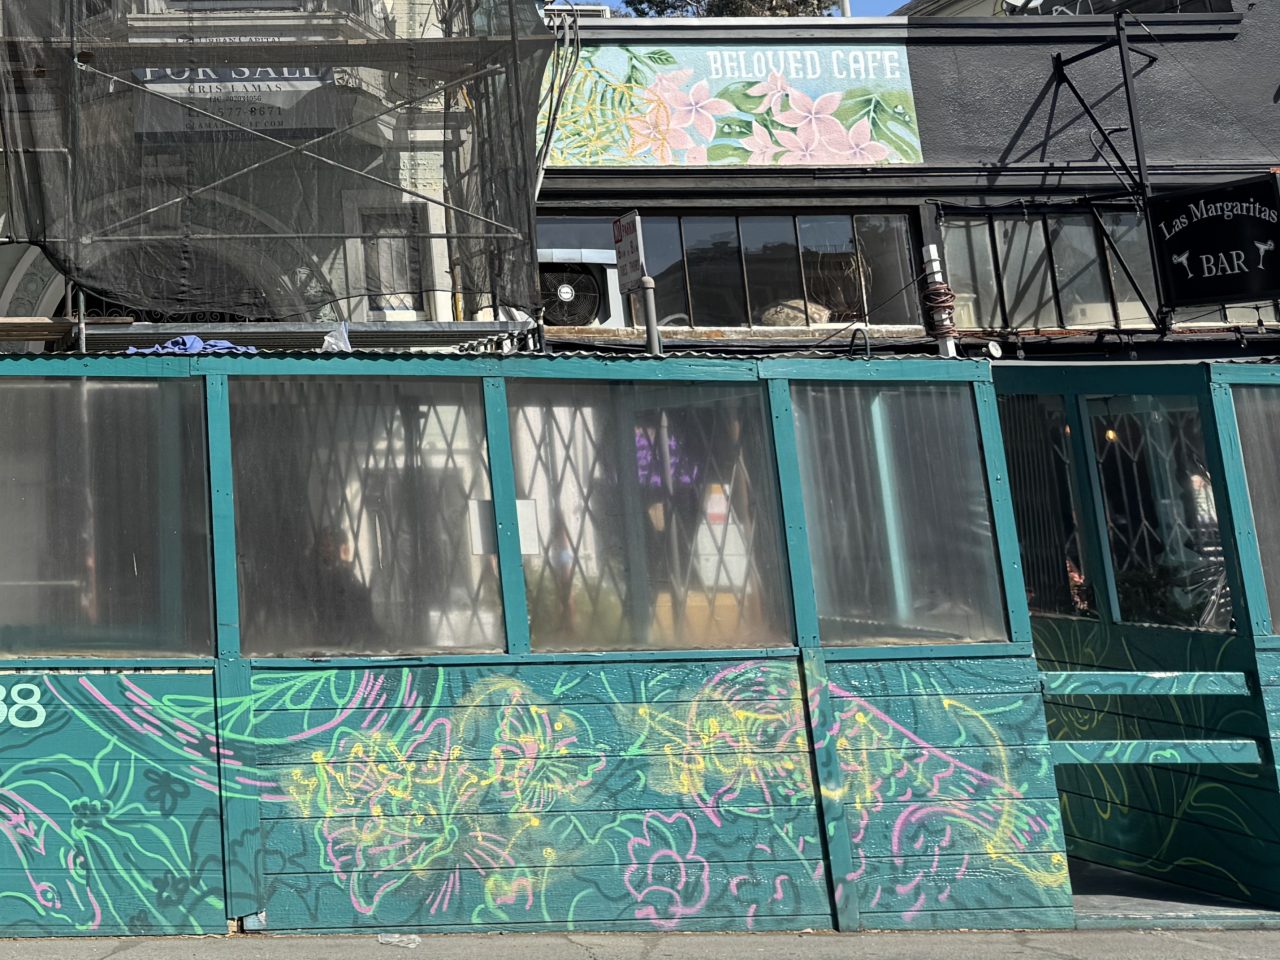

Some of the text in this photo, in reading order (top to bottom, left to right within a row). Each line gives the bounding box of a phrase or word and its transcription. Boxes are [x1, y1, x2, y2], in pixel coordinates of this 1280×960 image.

[706, 49, 901, 79] BELOVED CAFE
[187, 83, 282, 94] CRIS LAMAS
[1158, 197, 1278, 240] Las Margaritas
[1200, 250, 1249, 277] BAR
